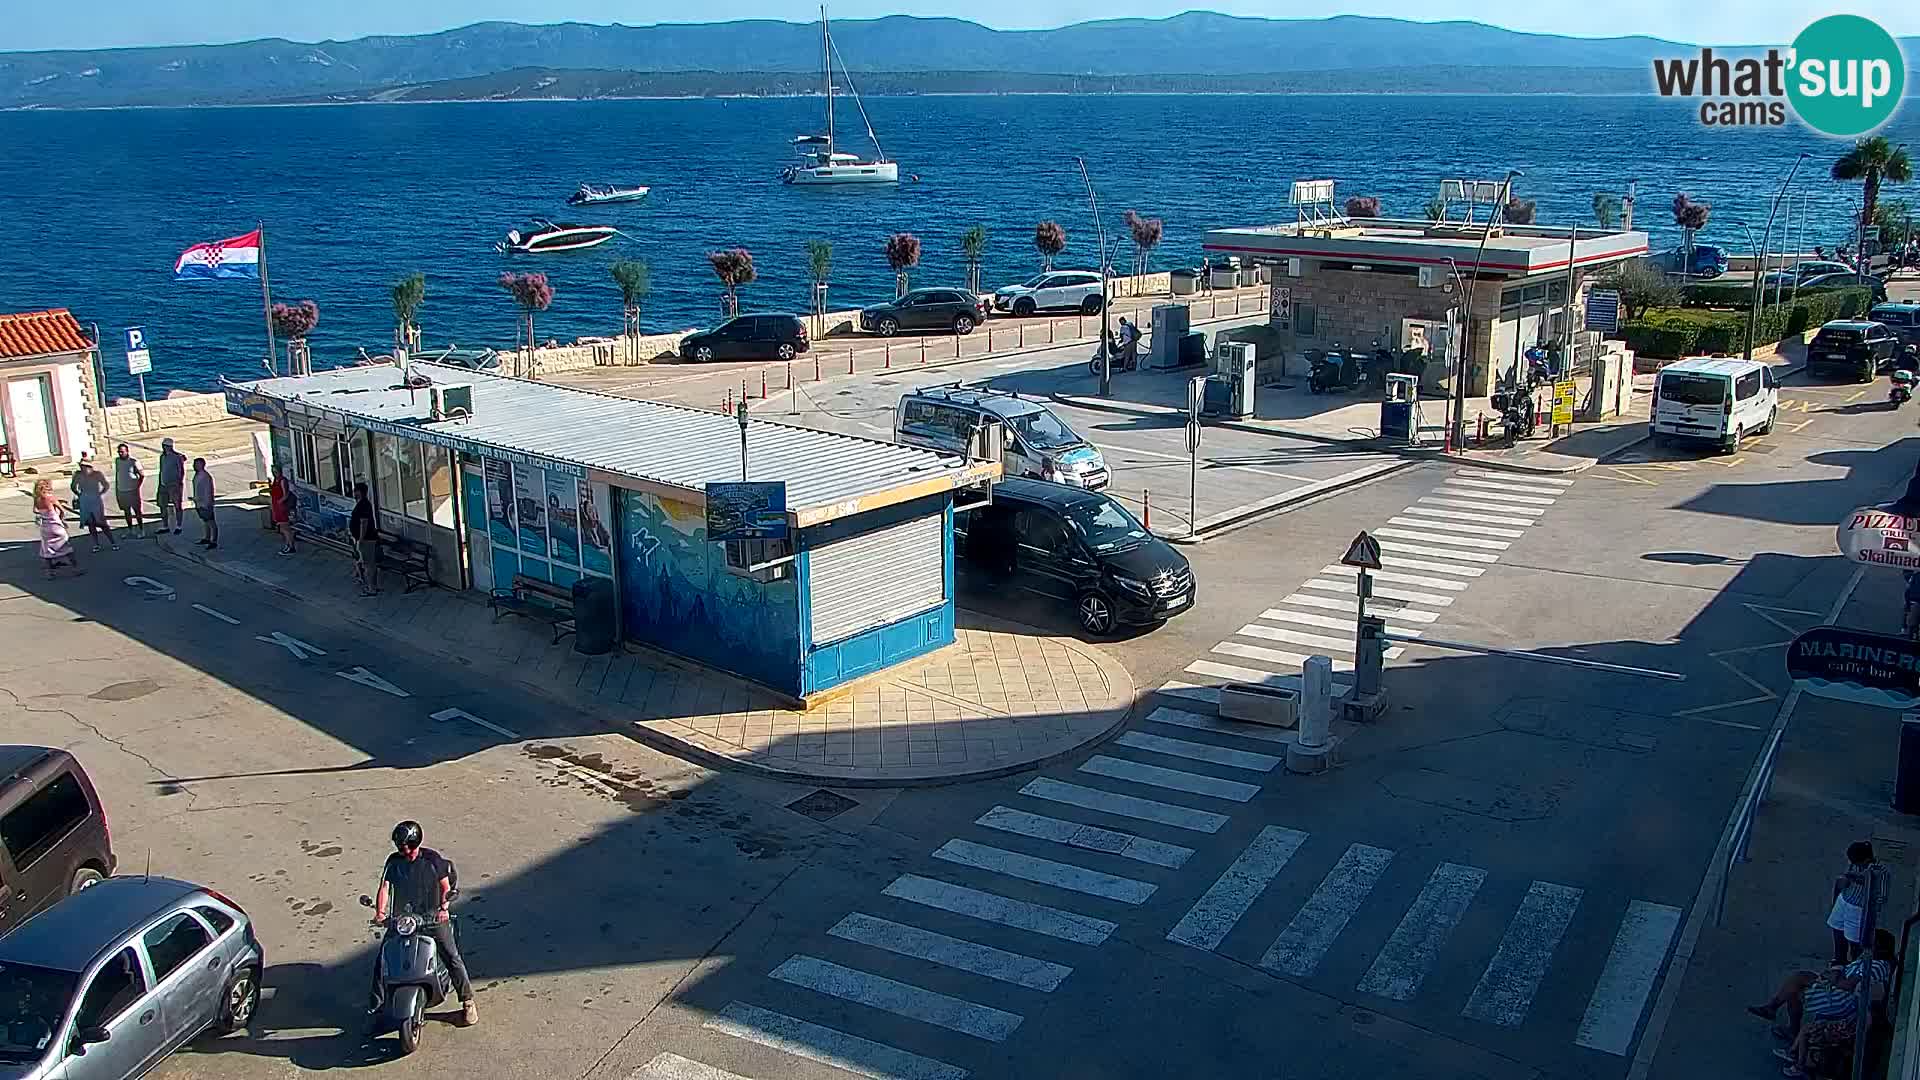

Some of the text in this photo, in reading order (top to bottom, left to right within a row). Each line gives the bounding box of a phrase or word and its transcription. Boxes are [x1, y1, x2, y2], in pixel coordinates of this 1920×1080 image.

[128, 330, 143, 349] P
[477, 446, 492, 458] BUS
[493, 449, 526, 465] STATION
[526, 457, 554, 470] TICKET
[555, 463, 582, 477] OFFICE
